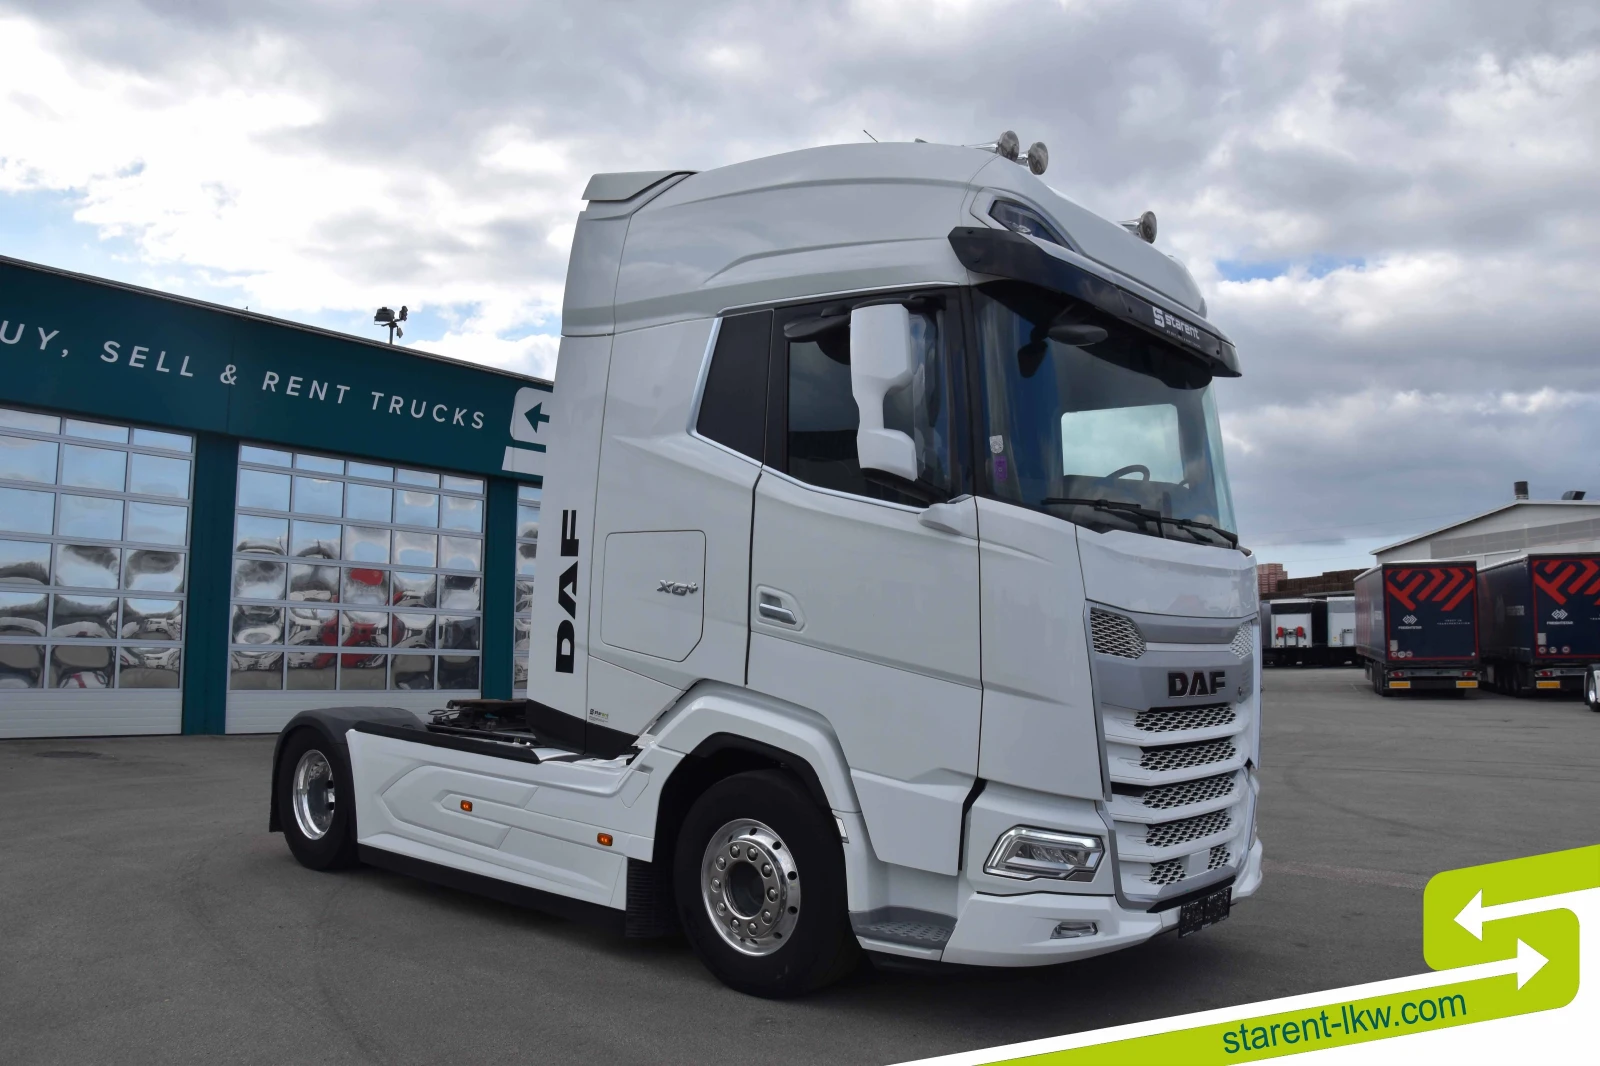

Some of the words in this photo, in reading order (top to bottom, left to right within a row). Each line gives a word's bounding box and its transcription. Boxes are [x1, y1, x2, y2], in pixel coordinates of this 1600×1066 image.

[1164, 313, 1201, 340] starent
[100, 341, 194, 377] SELL
[219, 364, 237, 386] &
[262, 371, 351, 405] RENT
[370, 391, 486, 430] TRUCKS
[555, 509, 579, 674] DAF
[1167, 670, 1226, 698] DAF
